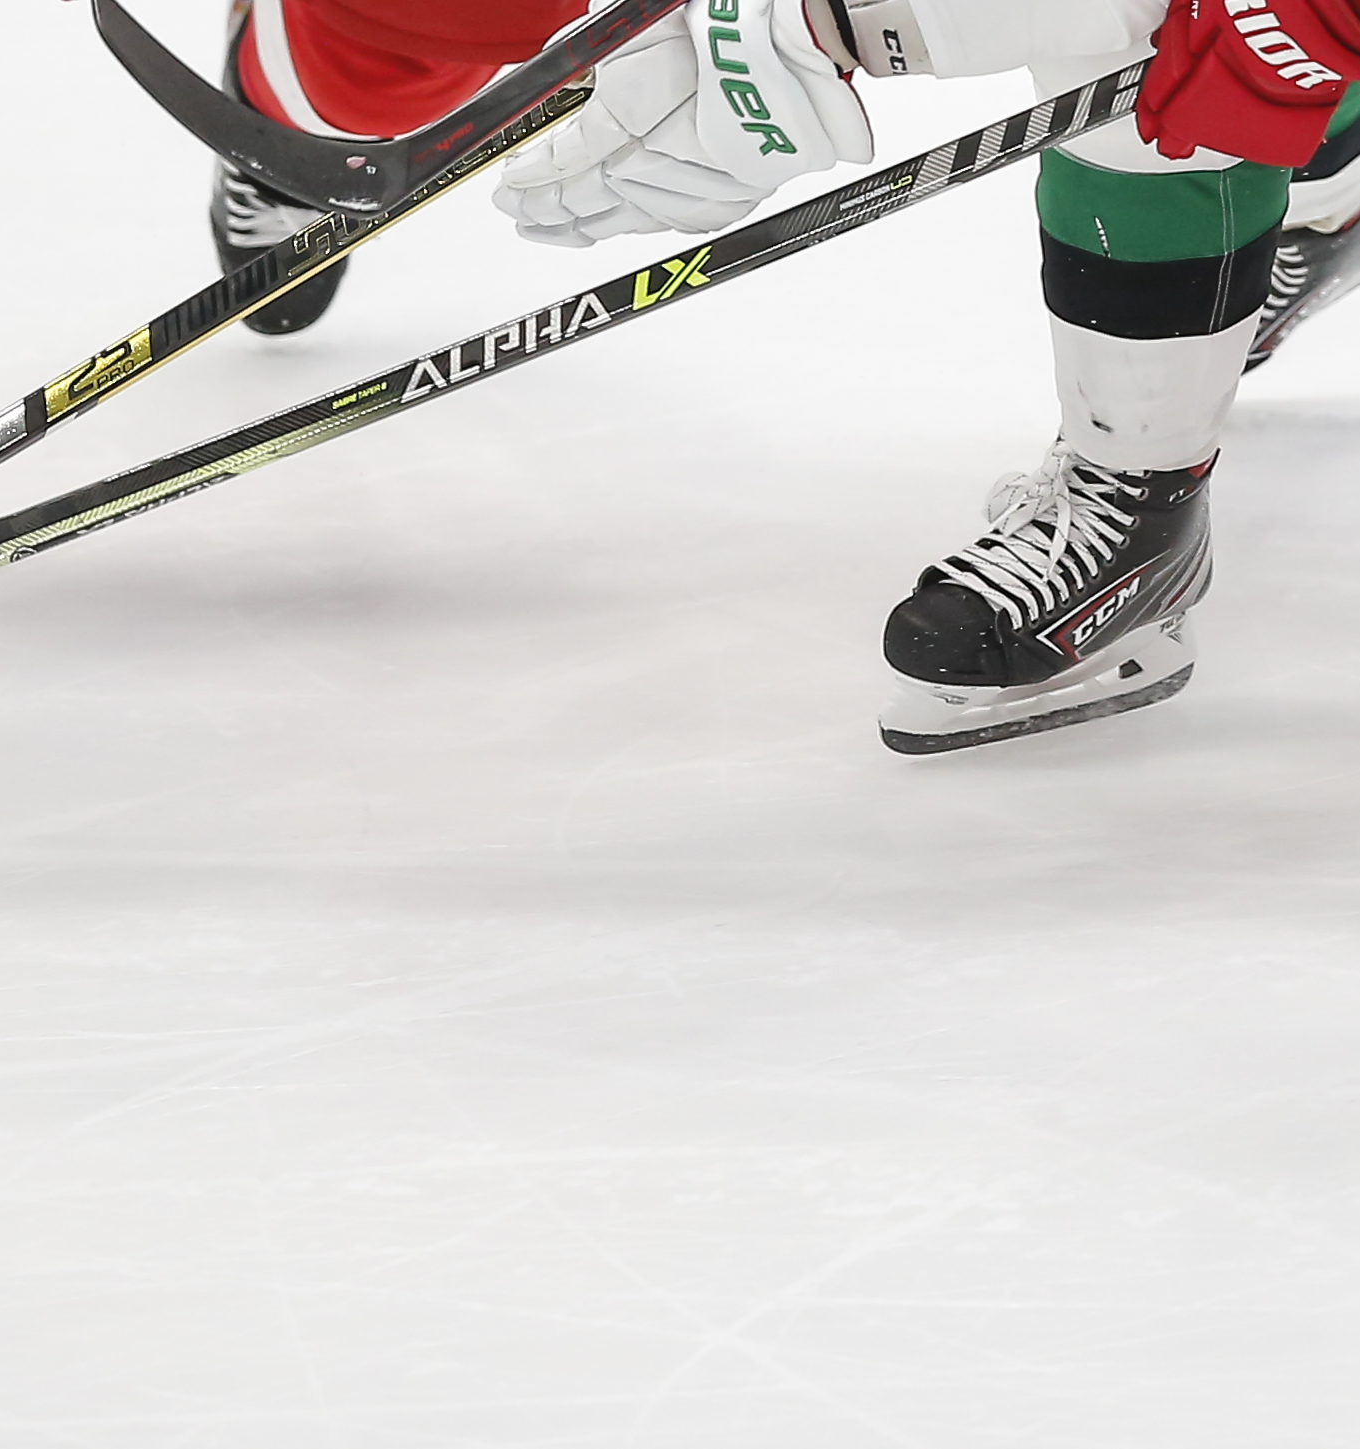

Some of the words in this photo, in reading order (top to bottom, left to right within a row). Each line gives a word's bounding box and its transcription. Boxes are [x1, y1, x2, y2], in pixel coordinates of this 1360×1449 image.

[882, 27, 908, 75] CC
[400, 292, 612, 403] ALPHA
[632, 245, 712, 310] LX
[1072, 576, 1141, 646] CCM
